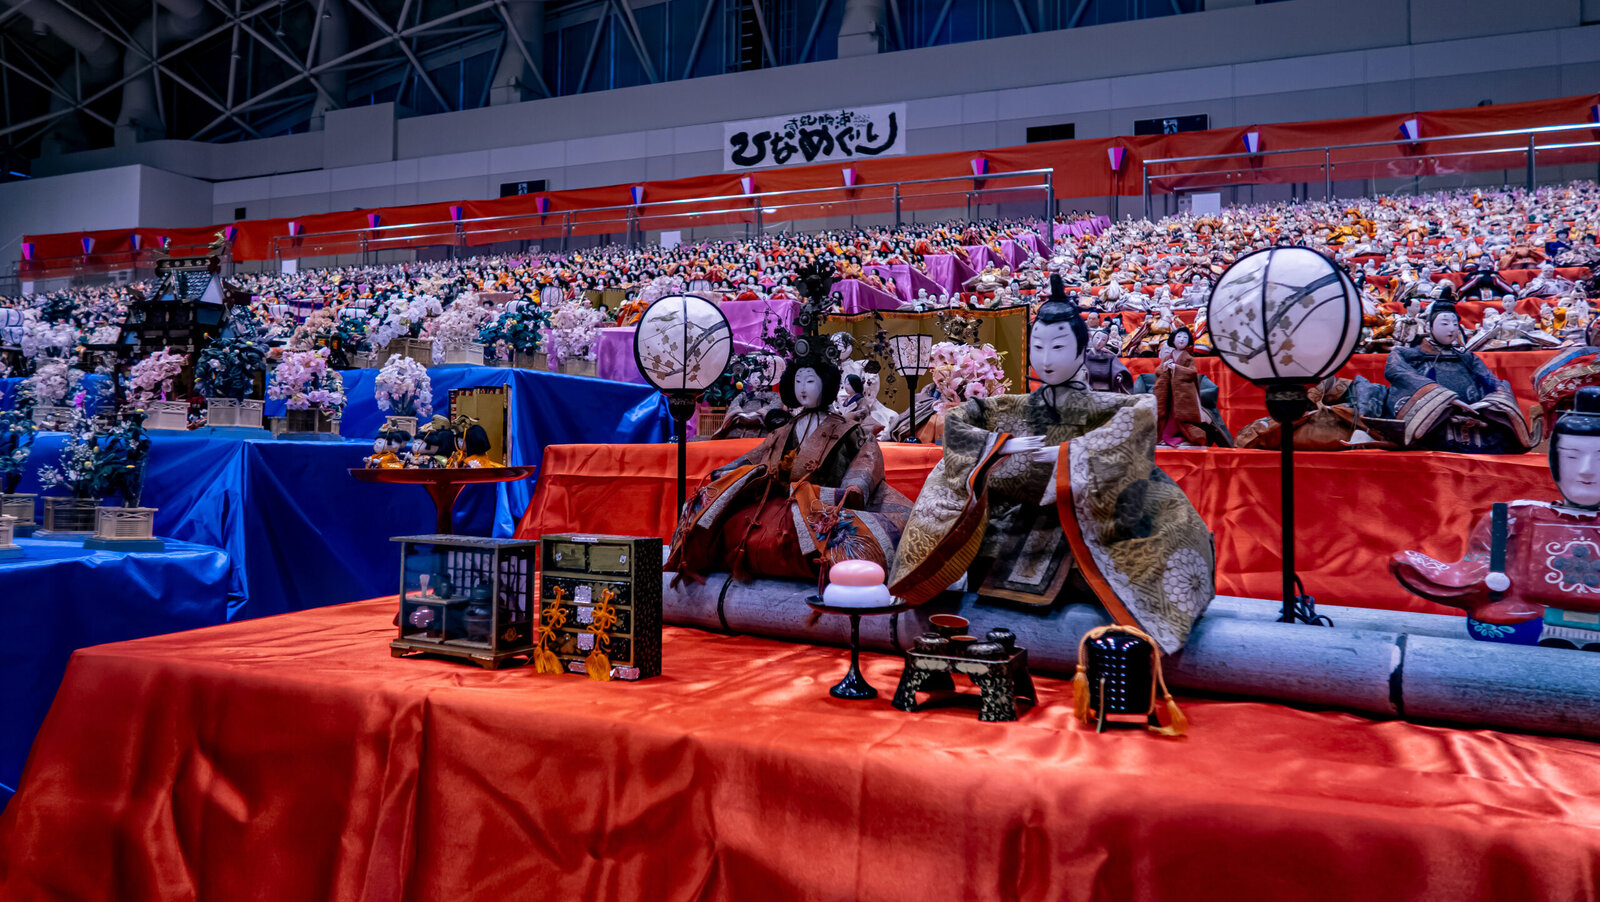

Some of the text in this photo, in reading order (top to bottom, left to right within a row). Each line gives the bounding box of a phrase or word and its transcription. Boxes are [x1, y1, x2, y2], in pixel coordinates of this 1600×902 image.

[730, 112, 898, 166] ひなめぐり
